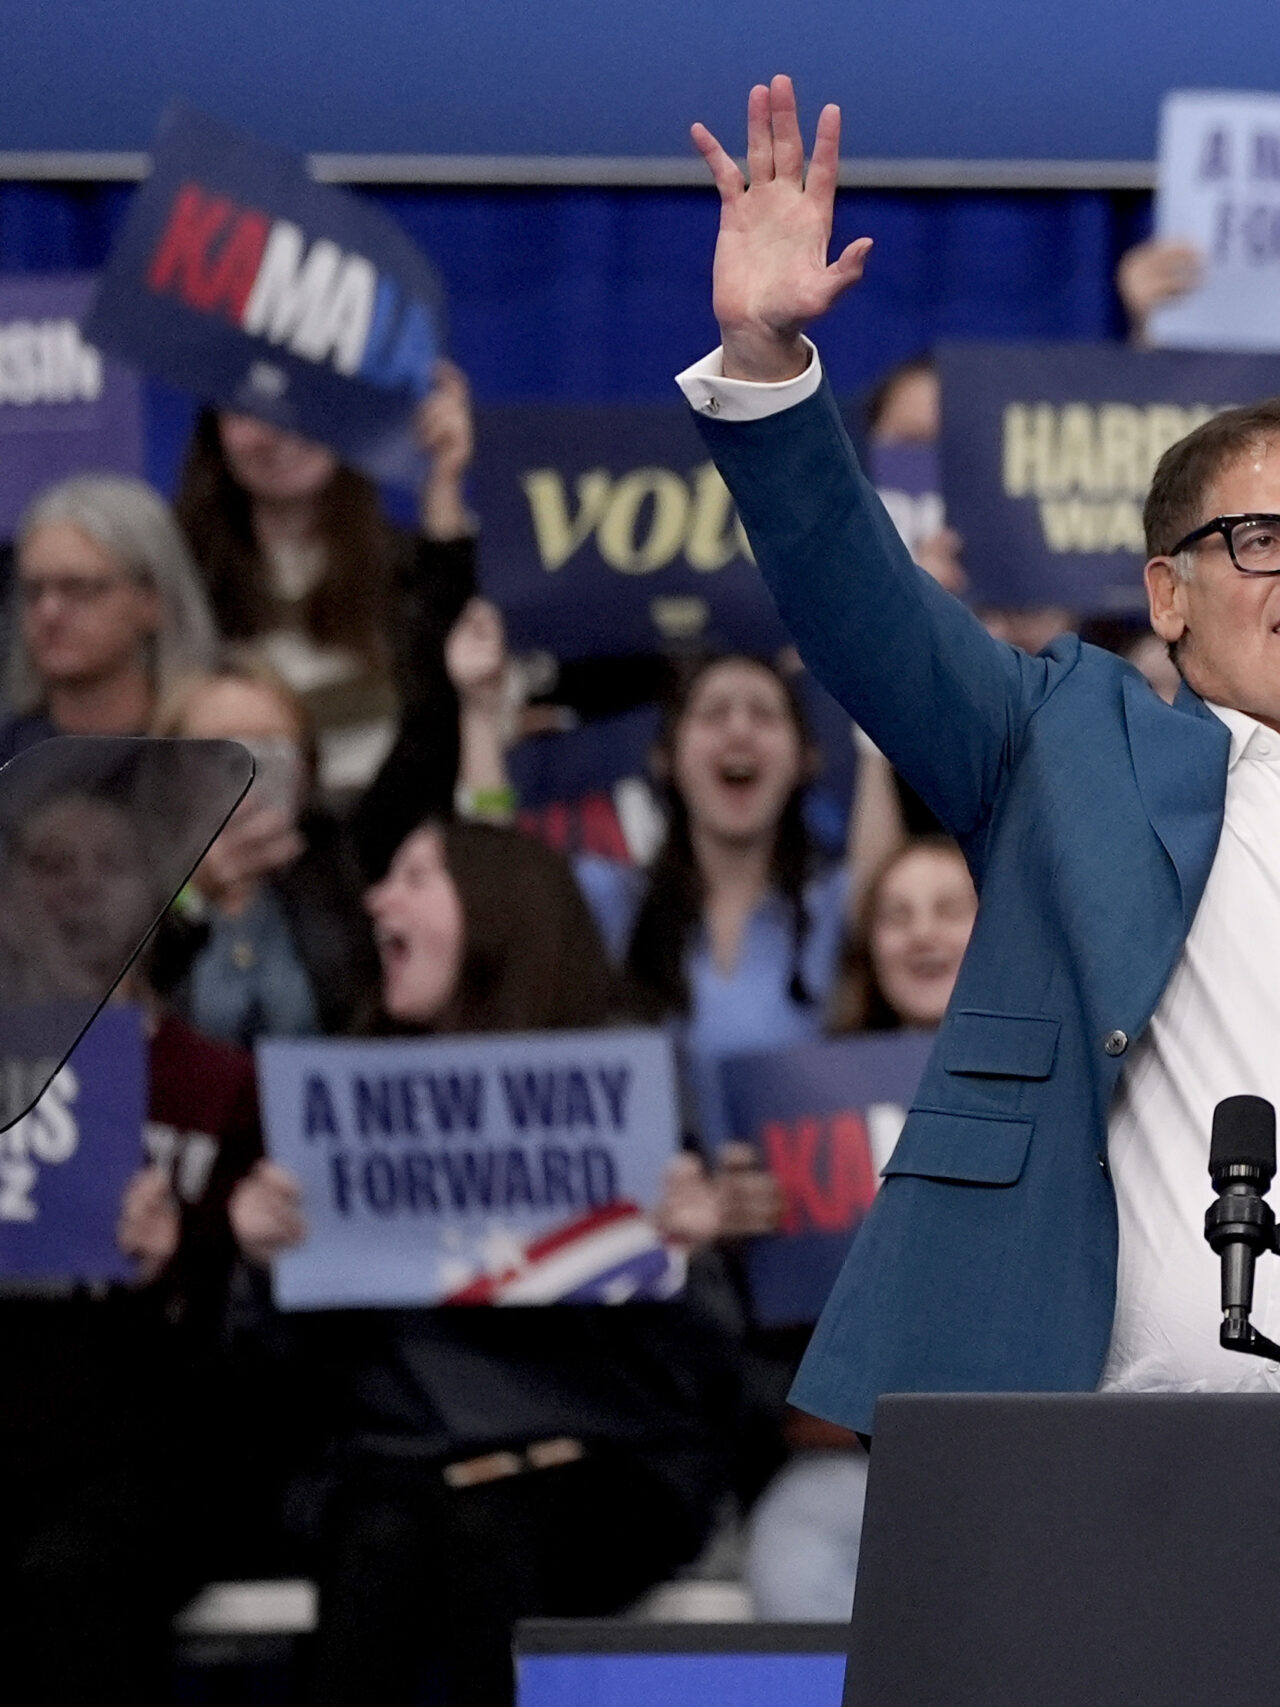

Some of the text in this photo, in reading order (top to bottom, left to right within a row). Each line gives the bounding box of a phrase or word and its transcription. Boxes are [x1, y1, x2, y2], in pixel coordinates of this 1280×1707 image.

[1200, 124, 1233, 183] A
[522, 458, 757, 576] vot
[304, 1062, 631, 1142] A NEW WAY
[330, 1144, 622, 1217] FORWARD
